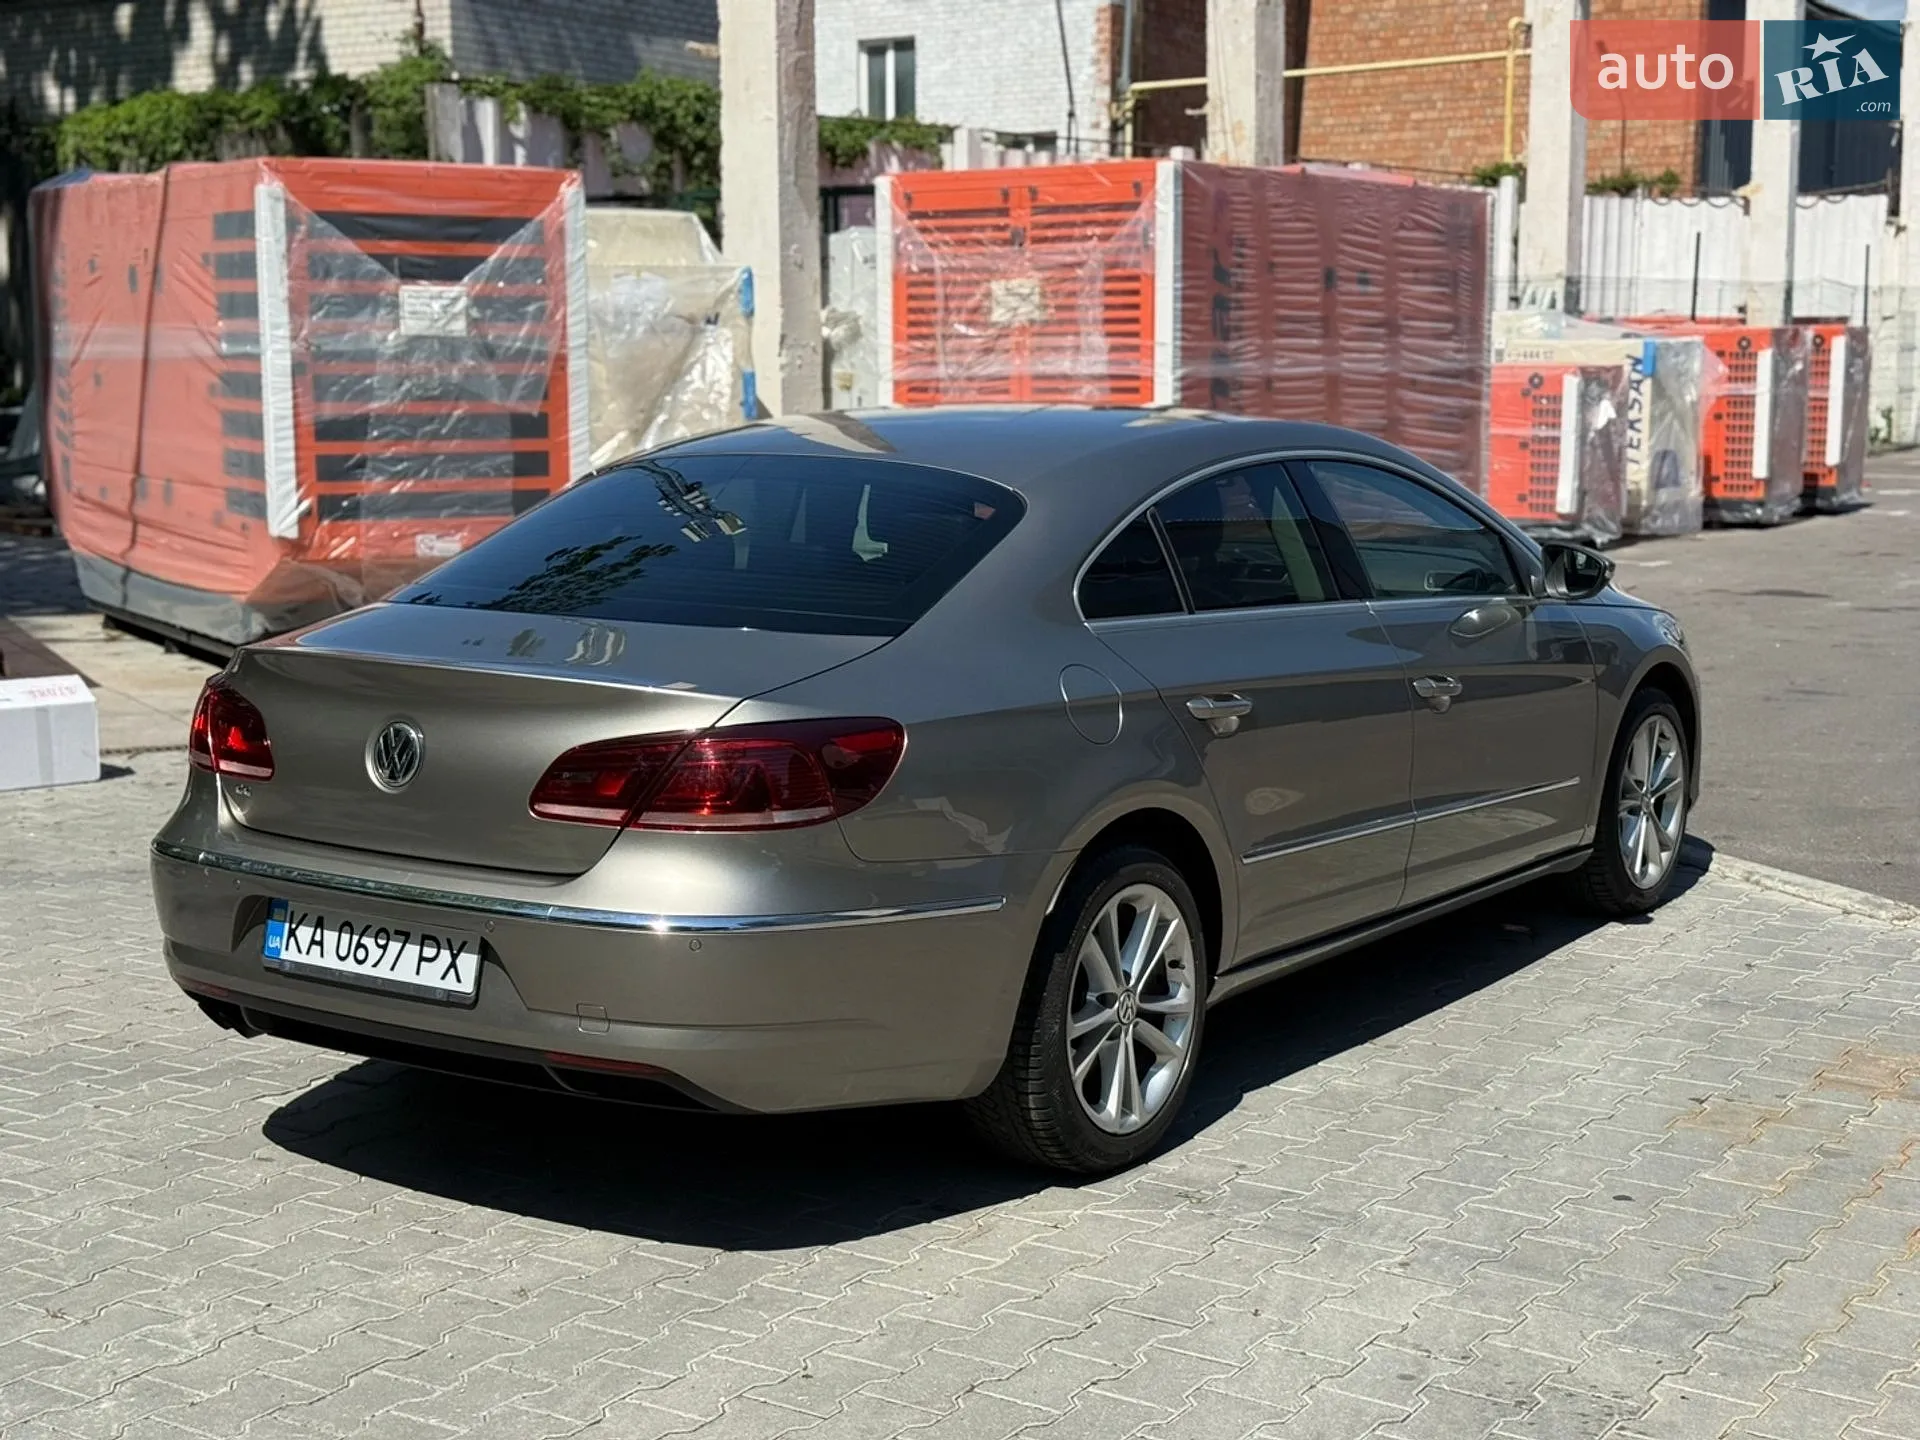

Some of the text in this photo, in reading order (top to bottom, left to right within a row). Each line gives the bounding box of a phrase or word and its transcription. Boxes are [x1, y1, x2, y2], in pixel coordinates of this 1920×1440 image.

[268, 936, 281, 950] UA
[285, 910, 468, 984] KA 0697 PX
